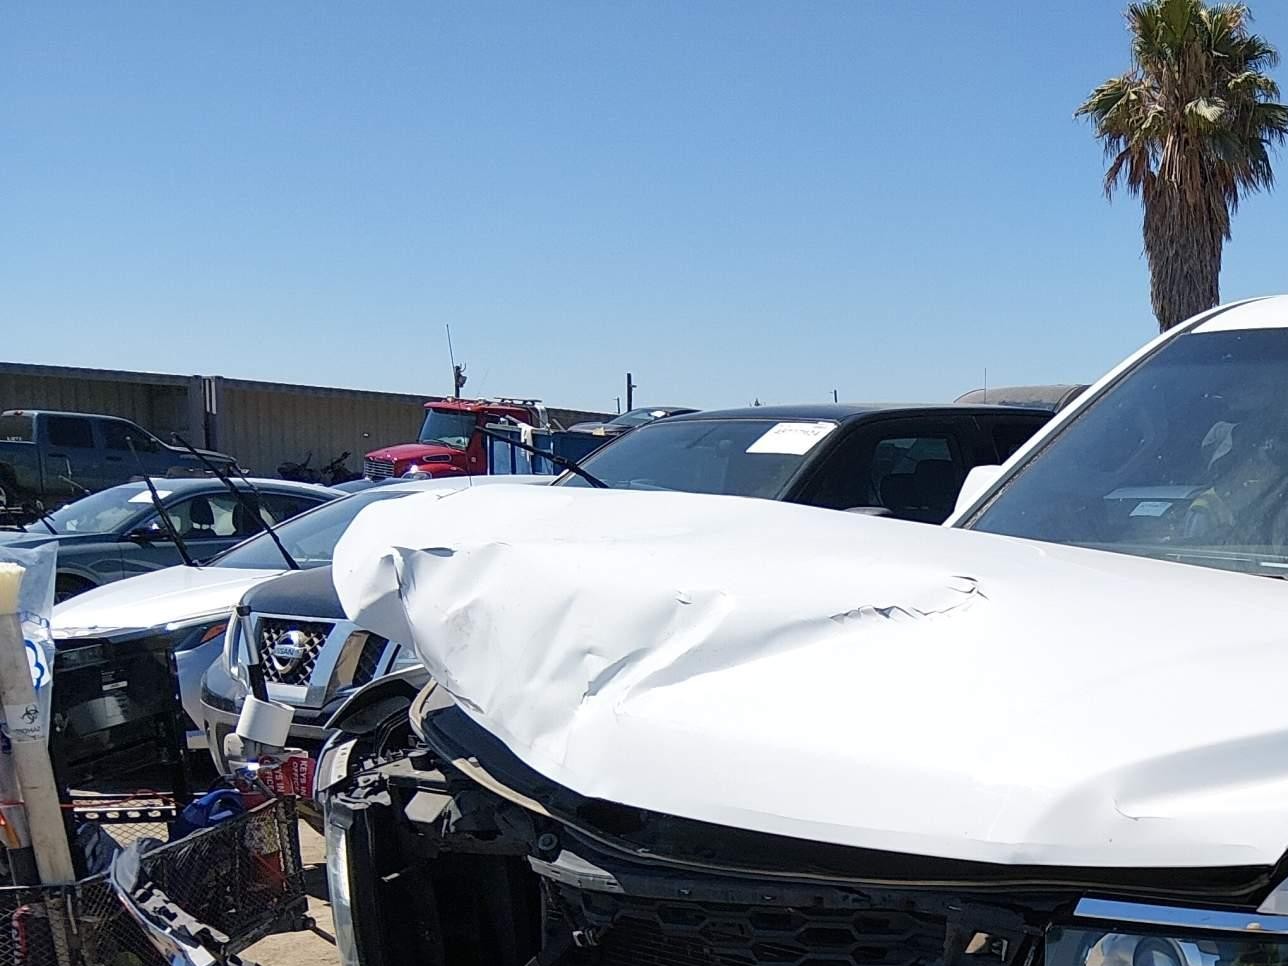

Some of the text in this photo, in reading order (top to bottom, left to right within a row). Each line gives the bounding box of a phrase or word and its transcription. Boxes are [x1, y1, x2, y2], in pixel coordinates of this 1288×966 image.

[276, 783, 285, 793] IN
[299, 760, 308, 796] KEYS IN
